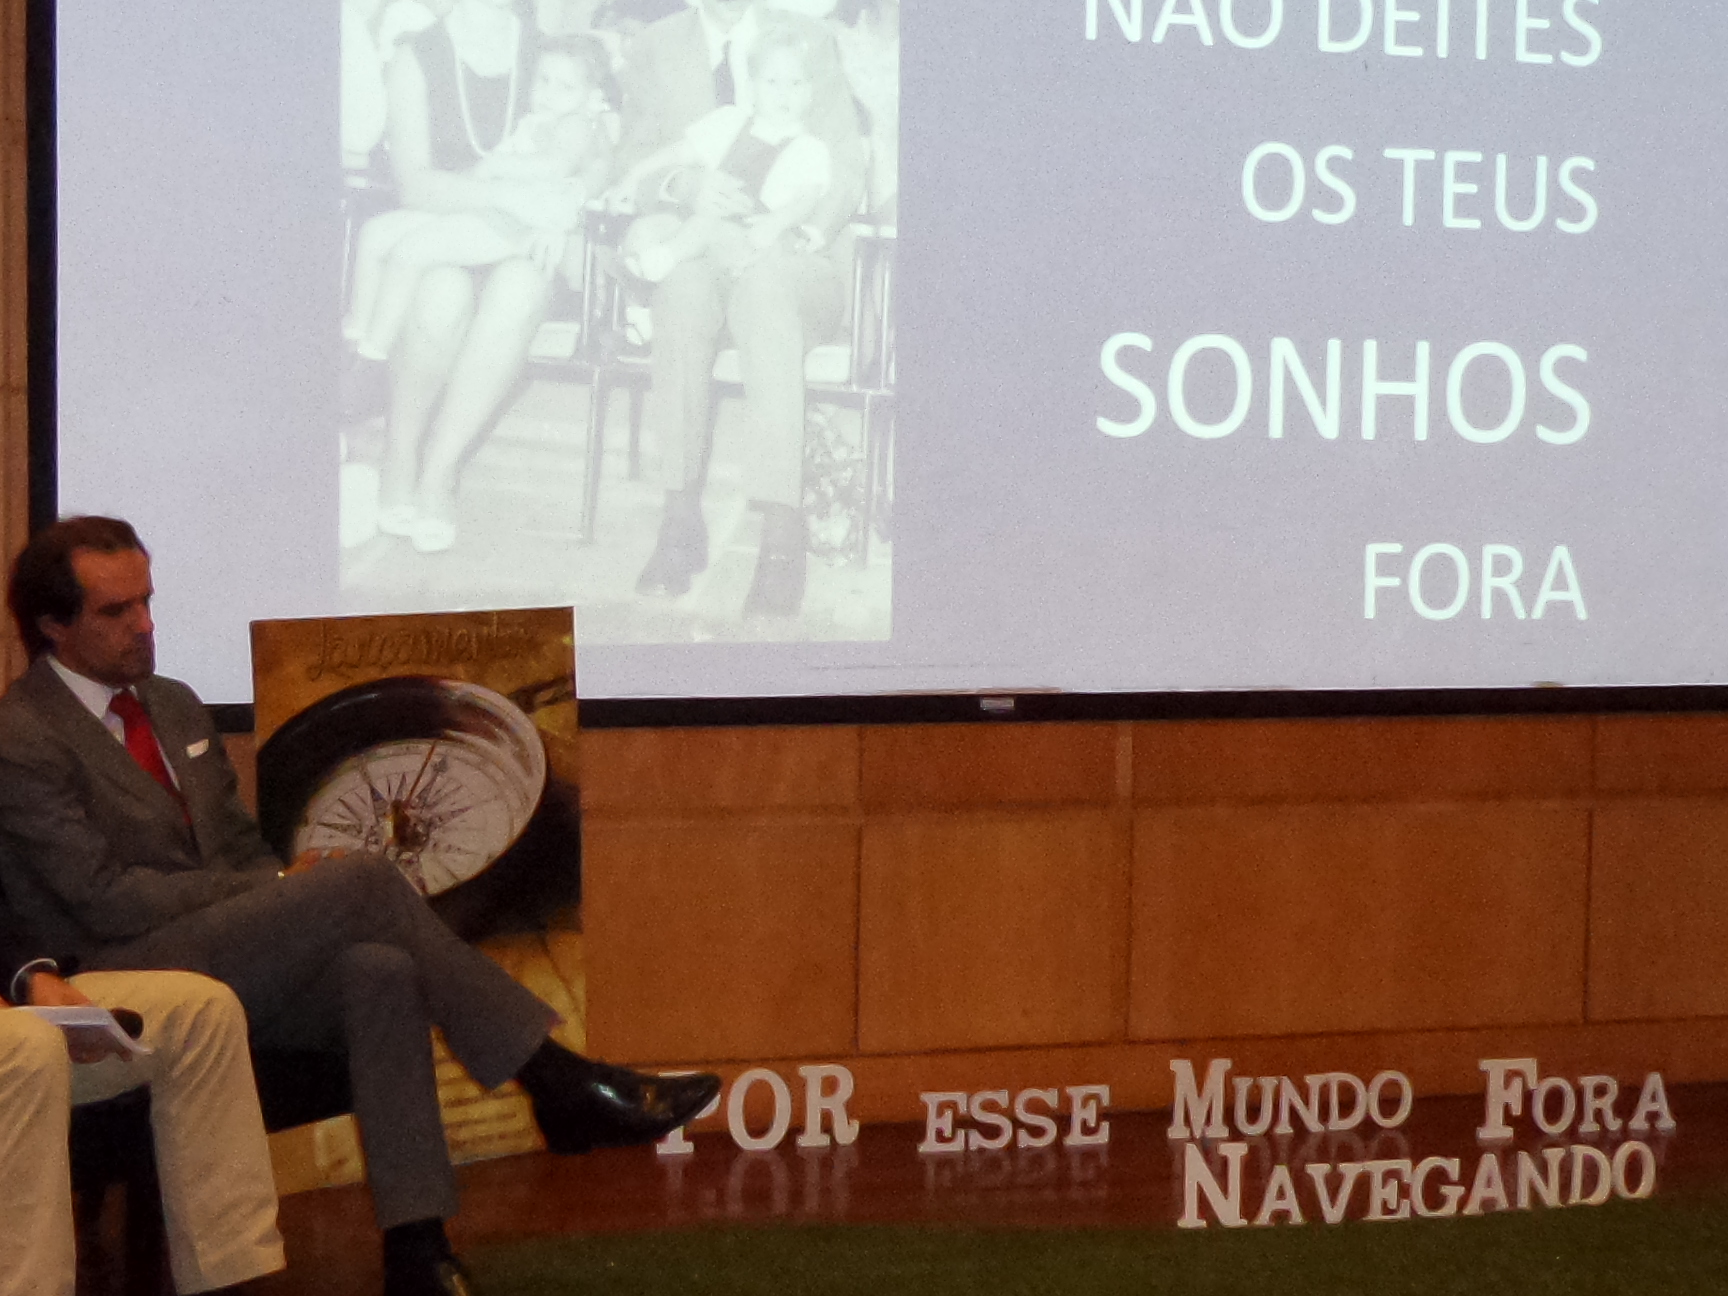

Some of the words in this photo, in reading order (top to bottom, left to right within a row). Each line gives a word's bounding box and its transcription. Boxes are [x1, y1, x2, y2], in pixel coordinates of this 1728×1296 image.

[1241, 141, 1357, 225] OS
[1383, 148, 1599, 234] TEUS
[1095, 332, 1592, 446] SONHOS
[1362, 543, 1589, 621] FORA
